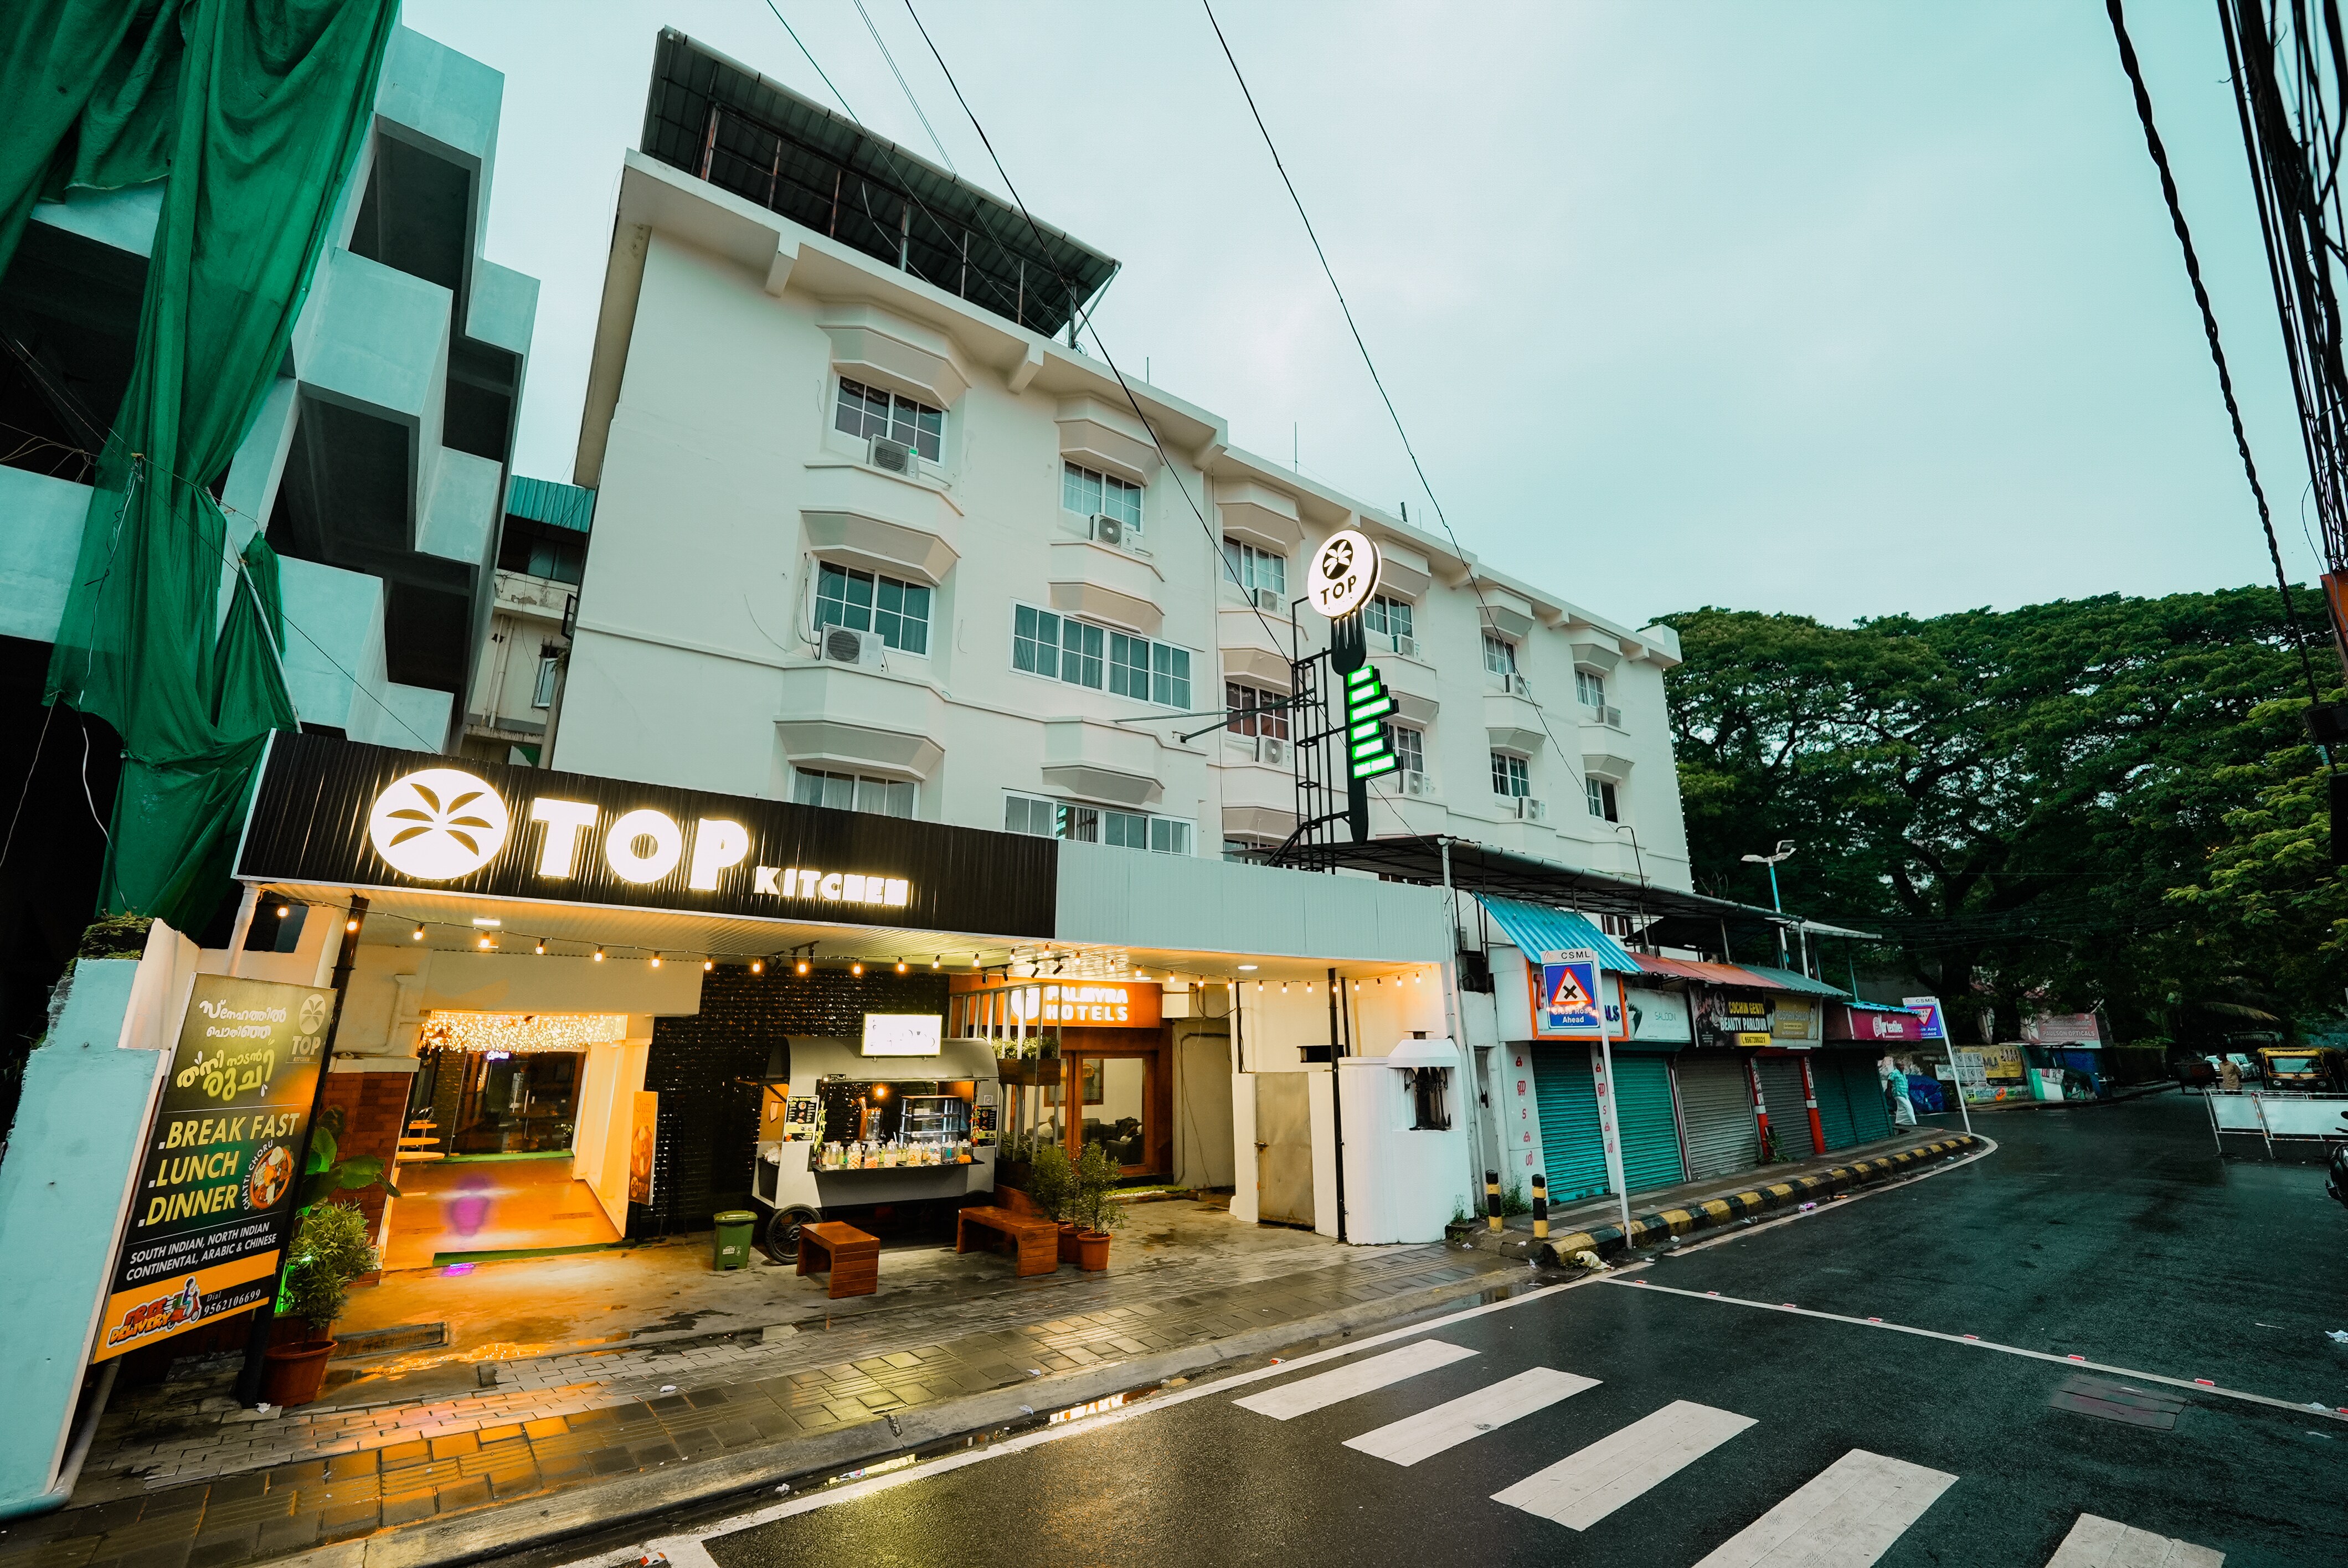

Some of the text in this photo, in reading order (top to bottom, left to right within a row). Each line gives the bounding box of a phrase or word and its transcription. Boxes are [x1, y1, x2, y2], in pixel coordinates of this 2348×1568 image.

[1320, 574, 1356, 605] TOP
[530, 797, 910, 907] TOP KITCHEN
[1561, 951, 1590, 960] CSML
[1046, 986, 1129, 1004] PALMYRA
[1728, 1002, 1765, 1015] COCHIN GENTS
[1046, 1004, 1128, 1022] HOTELS
[1655, 1012, 1676, 1021] SALOON
[1720, 1017, 1742, 1031] BEAUTY
[1742, 1018, 1768, 1031] PARLOUR
[291, 1035, 321, 1056] TOP
[166, 1112, 301, 1149] BREAK FAST
[156, 1150, 240, 1187] LUNCH
[241, 1139, 274, 1210] CHATTI CHORU
[639, 1182, 649, 1194] TOP
[145, 1184, 239, 1226] DINNER
[126, 1232, 277, 1281] CONTINENTAL, ARABIC & CHINESE
[130, 1221, 270, 1265] SOUTH INDIAN, NORTH INDIAN
[203, 1288, 261, 1317] 9562106699
[207, 1291, 222, 1302] Dial
[123, 1297, 168, 1325] FREE
[110, 1310, 174, 1344] DELIVERY
